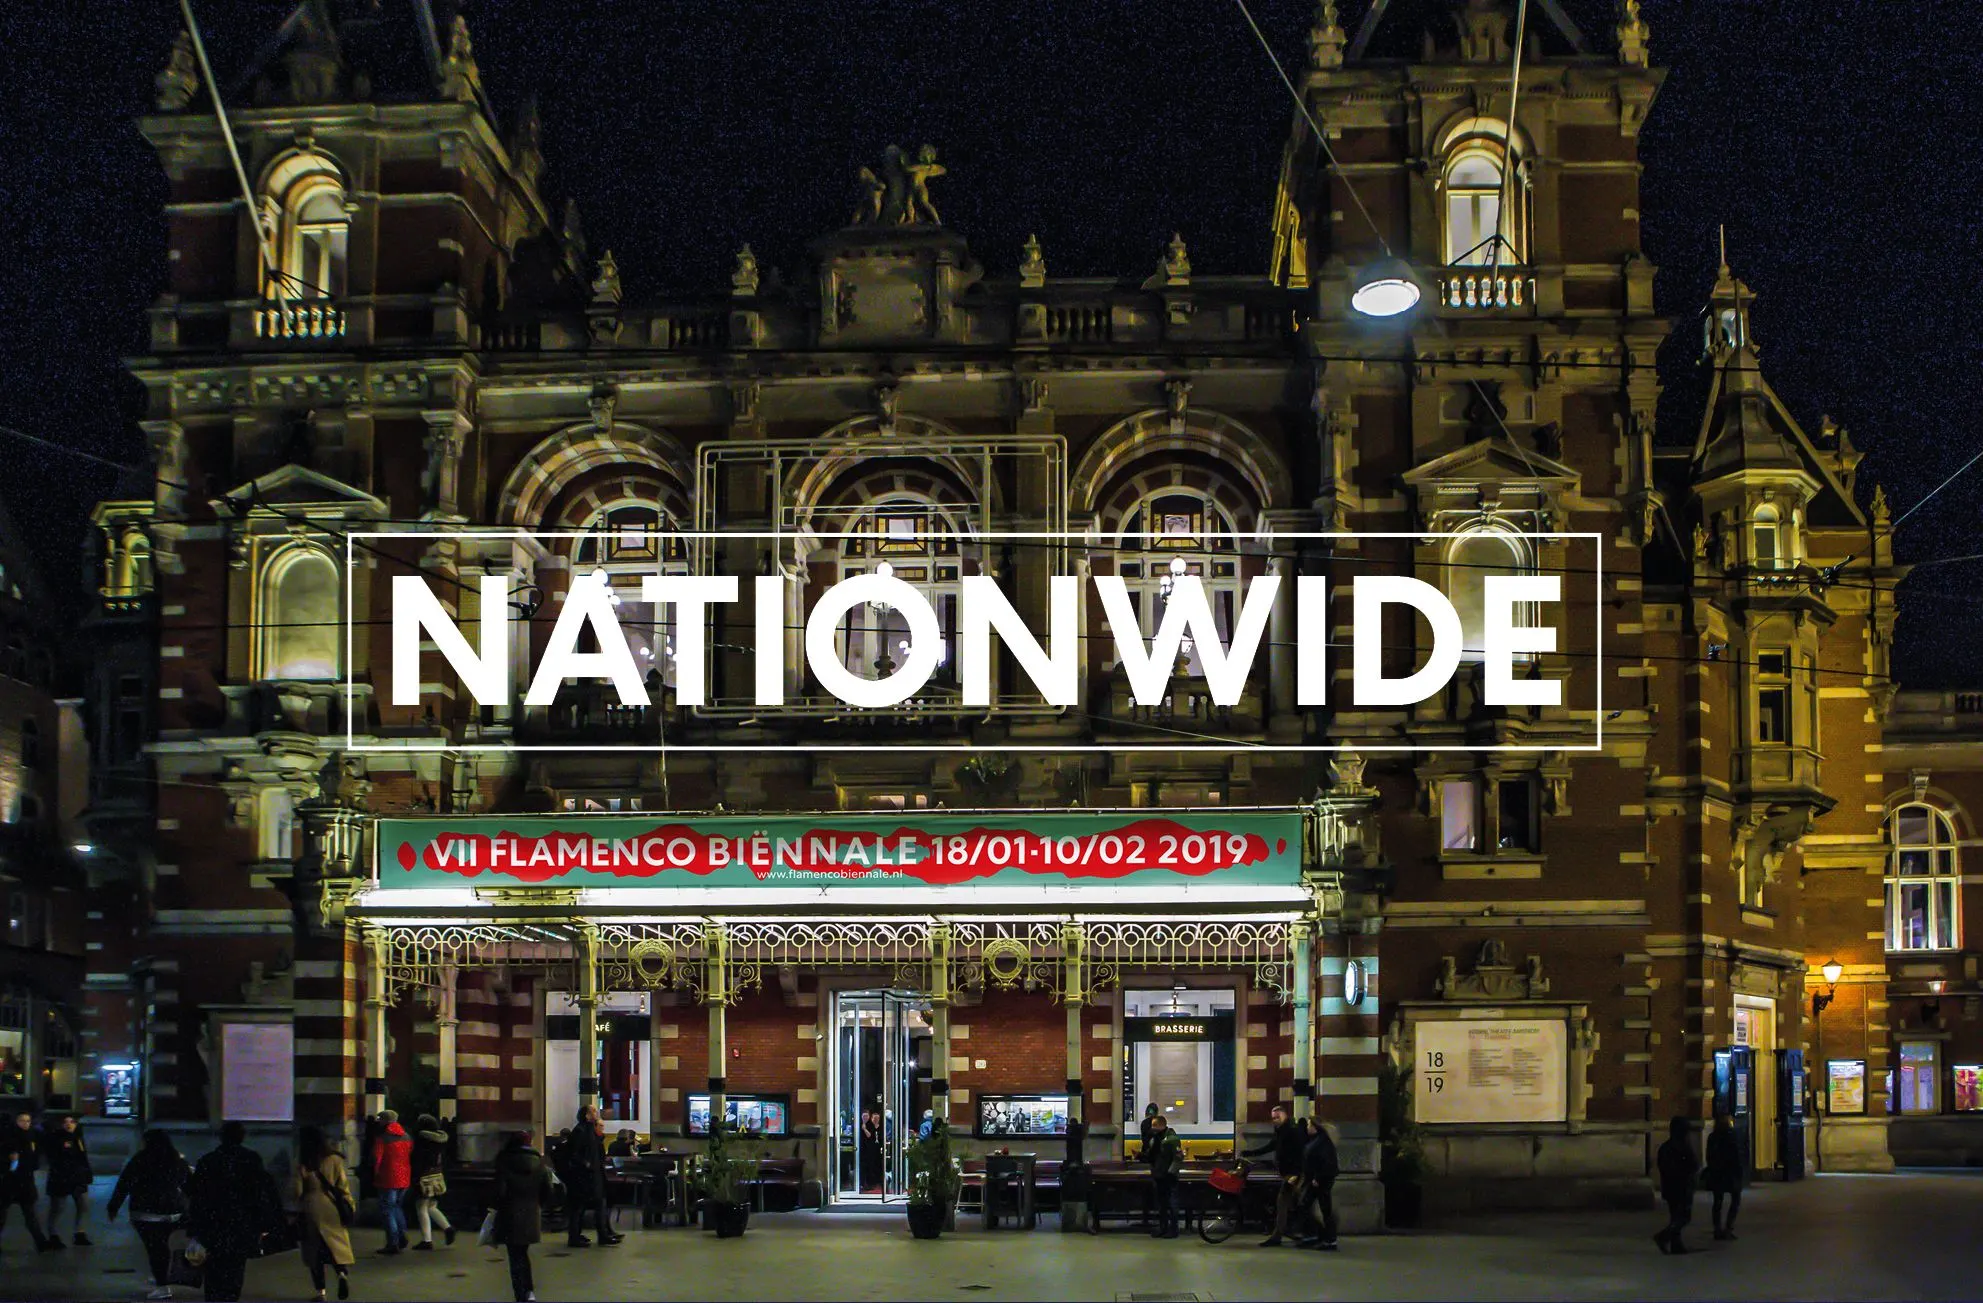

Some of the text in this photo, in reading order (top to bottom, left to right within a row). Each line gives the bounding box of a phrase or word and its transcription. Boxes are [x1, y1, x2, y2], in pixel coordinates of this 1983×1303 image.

[429, 838, 477, 867] VII
[490, 837, 696, 867] FLAMENCO
[709, 829, 917, 866] BIËNNALE
[1158, 834, 1248, 865] 2019
[757, 868, 904, 880] www.flamencobiennale.nl
[595, 1021, 610, 1032] AFÉ
[1154, 1024, 1204, 1034] BRASSERIE
[1427, 1052, 1444, 1068] 18
[1427, 1077, 1444, 1094] 19
